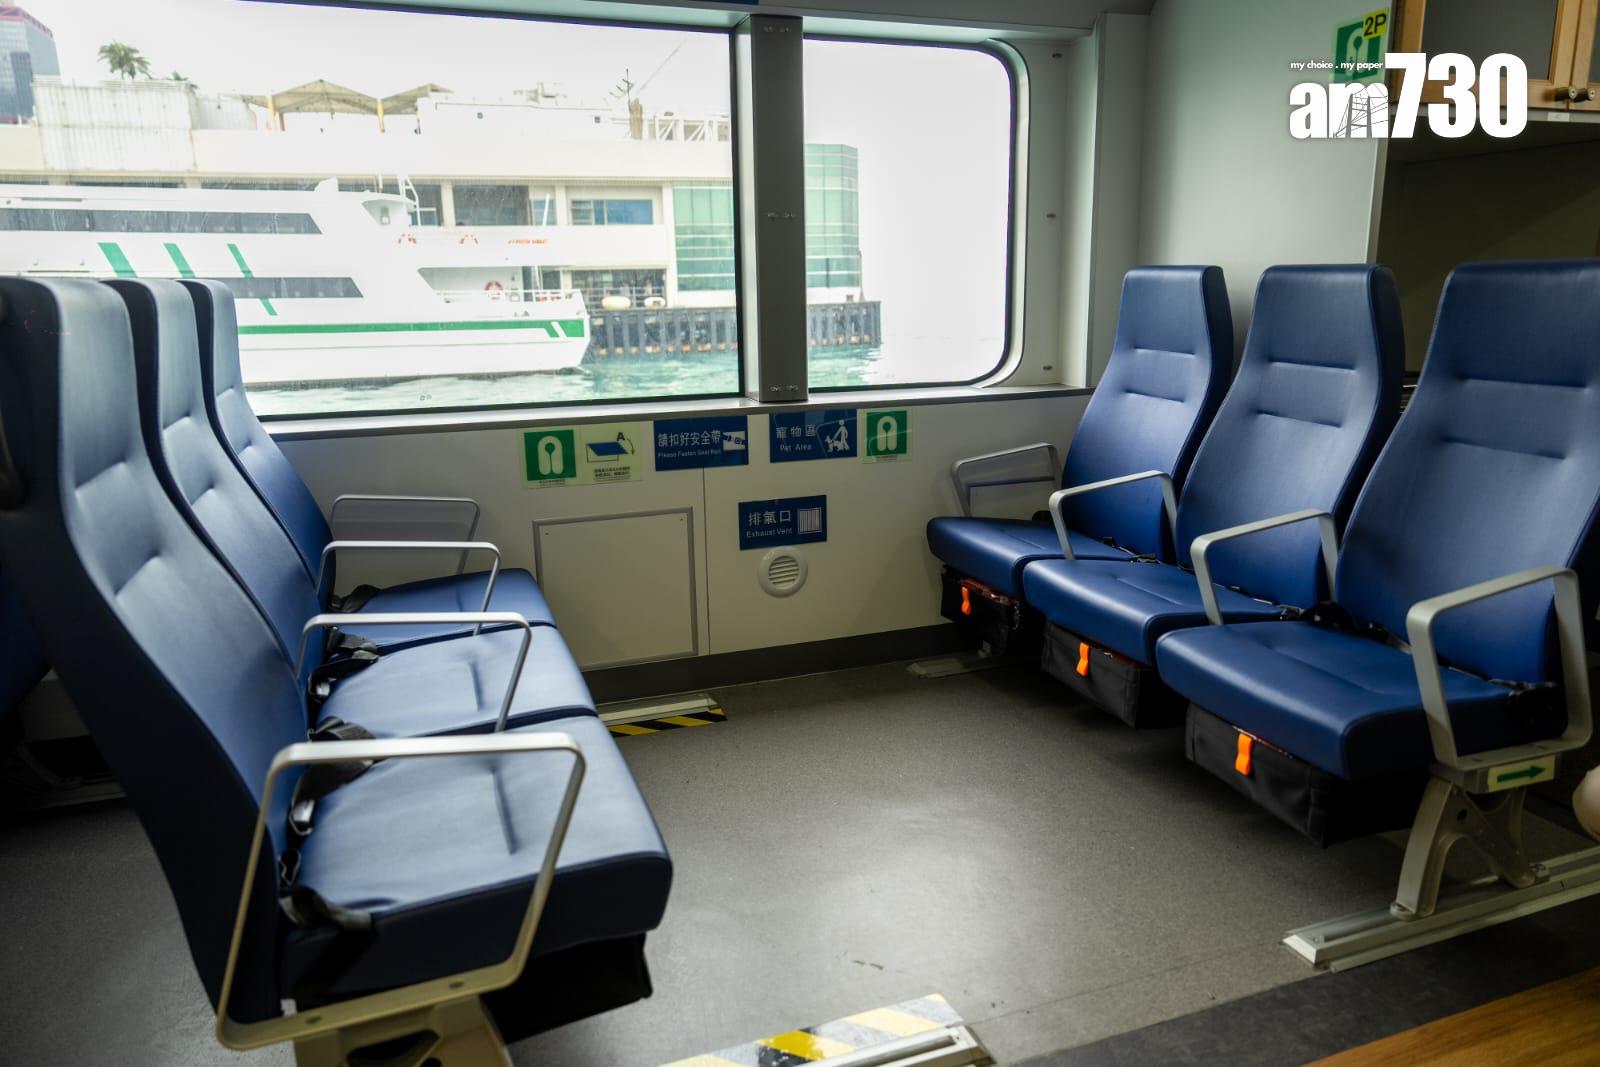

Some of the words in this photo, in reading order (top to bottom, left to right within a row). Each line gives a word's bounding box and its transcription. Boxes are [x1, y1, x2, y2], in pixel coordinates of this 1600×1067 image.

[1363, 13, 1387, 37] 2P
[616, 432, 626, 441] A
[658, 430, 721, 448] 請扣好安全帶
[795, 443, 813, 451] Area
[748, 510, 791, 527] 排氣口
[746, 529, 776, 538] Exhaust
[777, 528, 793, 536] Vent
